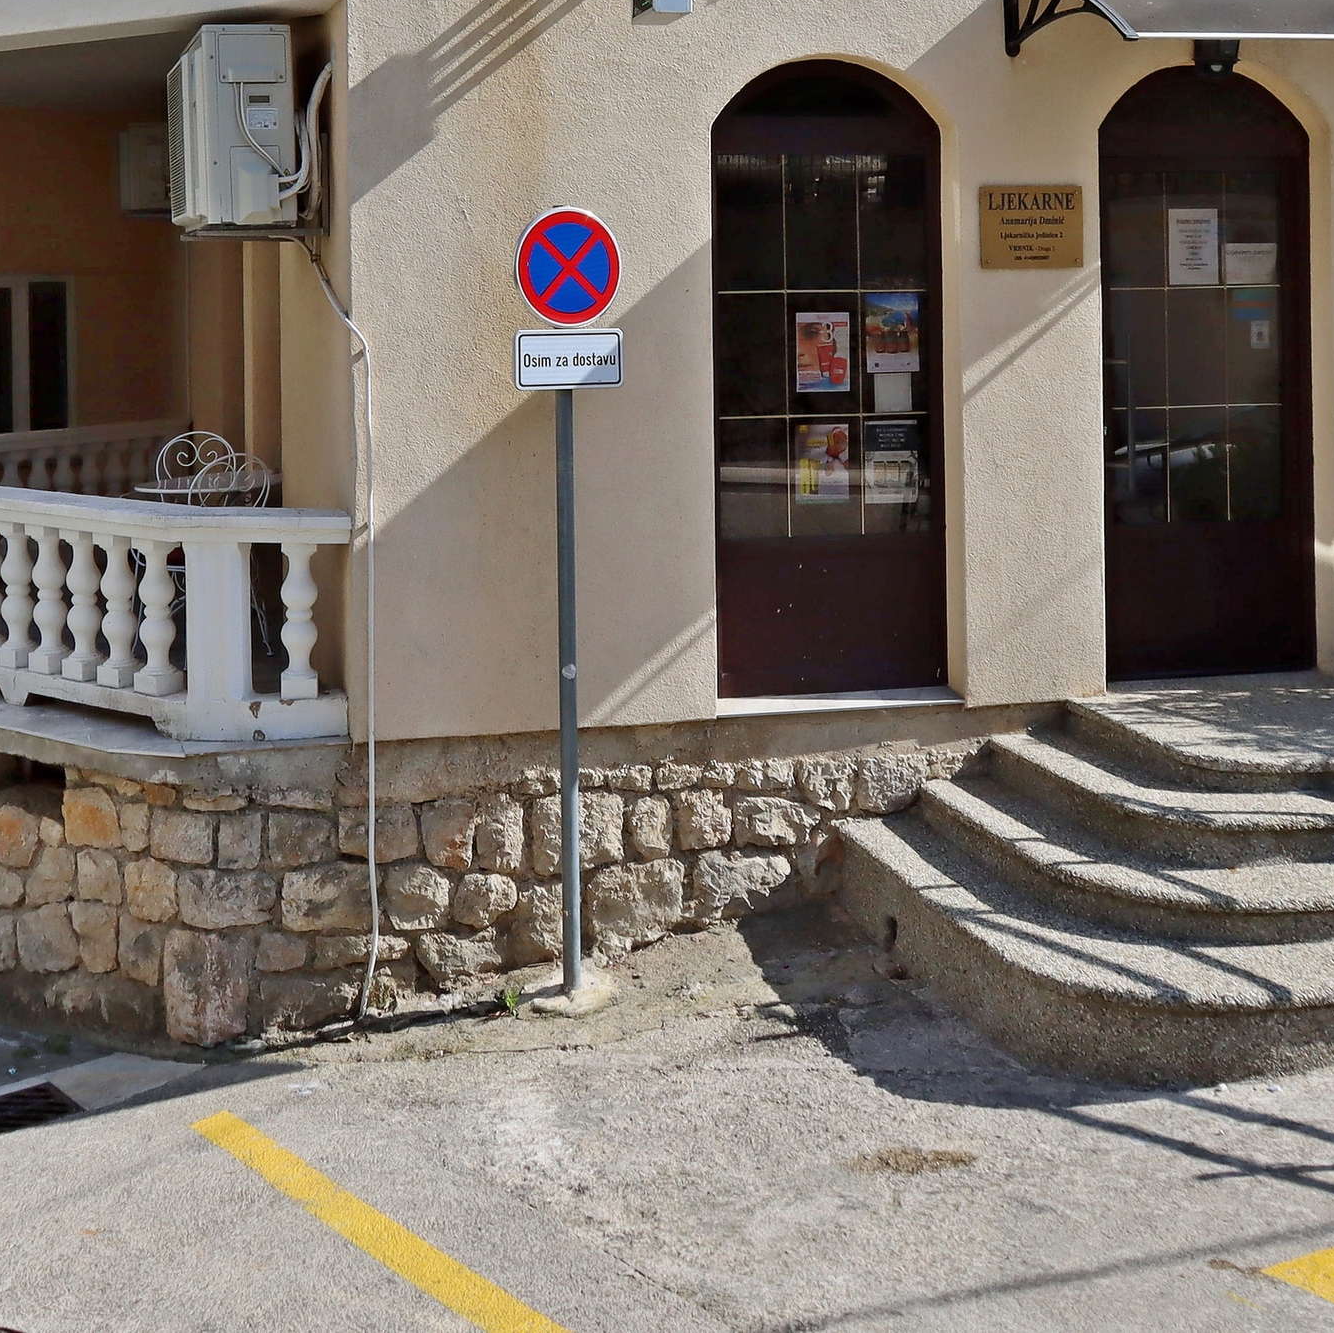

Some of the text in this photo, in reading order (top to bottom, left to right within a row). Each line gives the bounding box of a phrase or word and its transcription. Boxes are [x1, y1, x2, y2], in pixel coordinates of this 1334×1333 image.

[988, 192, 1075, 211] LJEKARNE
[1000, 216, 1037, 227] Anamarija
[523, 352, 616, 368] Osim za dostavu
